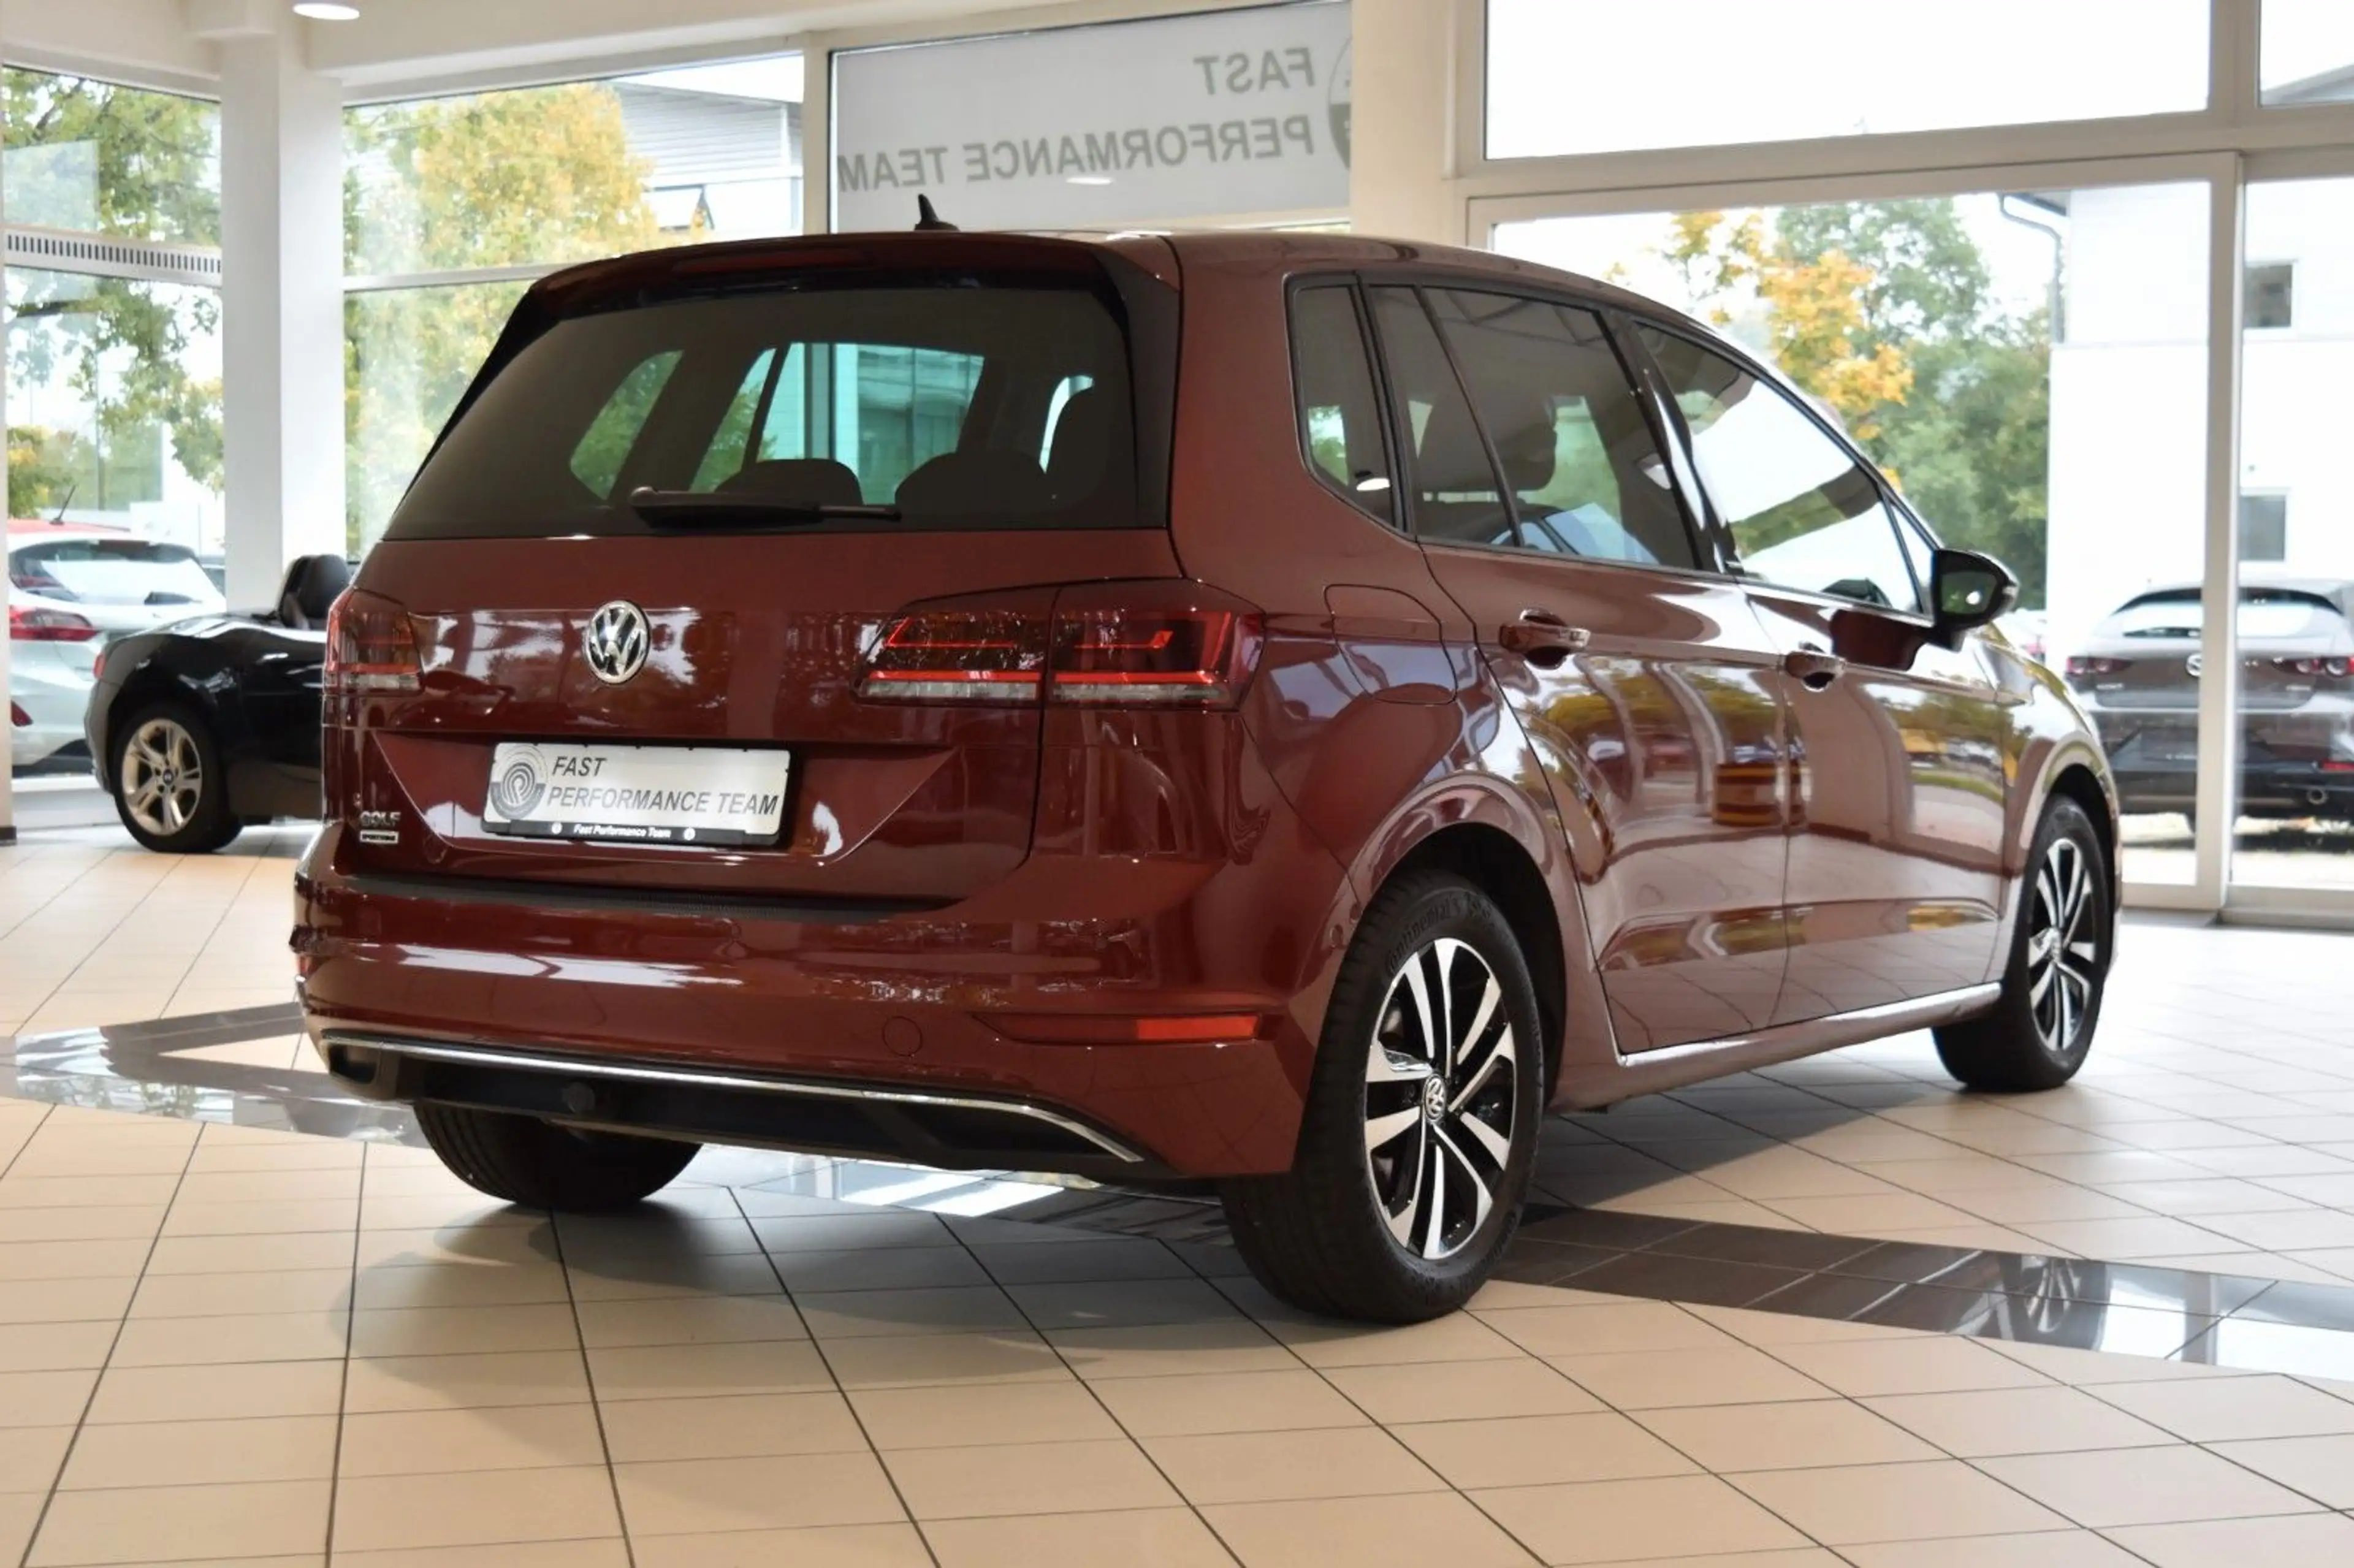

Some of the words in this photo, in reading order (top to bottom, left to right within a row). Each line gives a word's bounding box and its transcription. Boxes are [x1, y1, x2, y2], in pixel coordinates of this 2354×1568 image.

[552, 756, 607, 777] FAST
[547, 786, 711, 813] PERFORMANCE
[718, 793, 779, 815] TEAM
